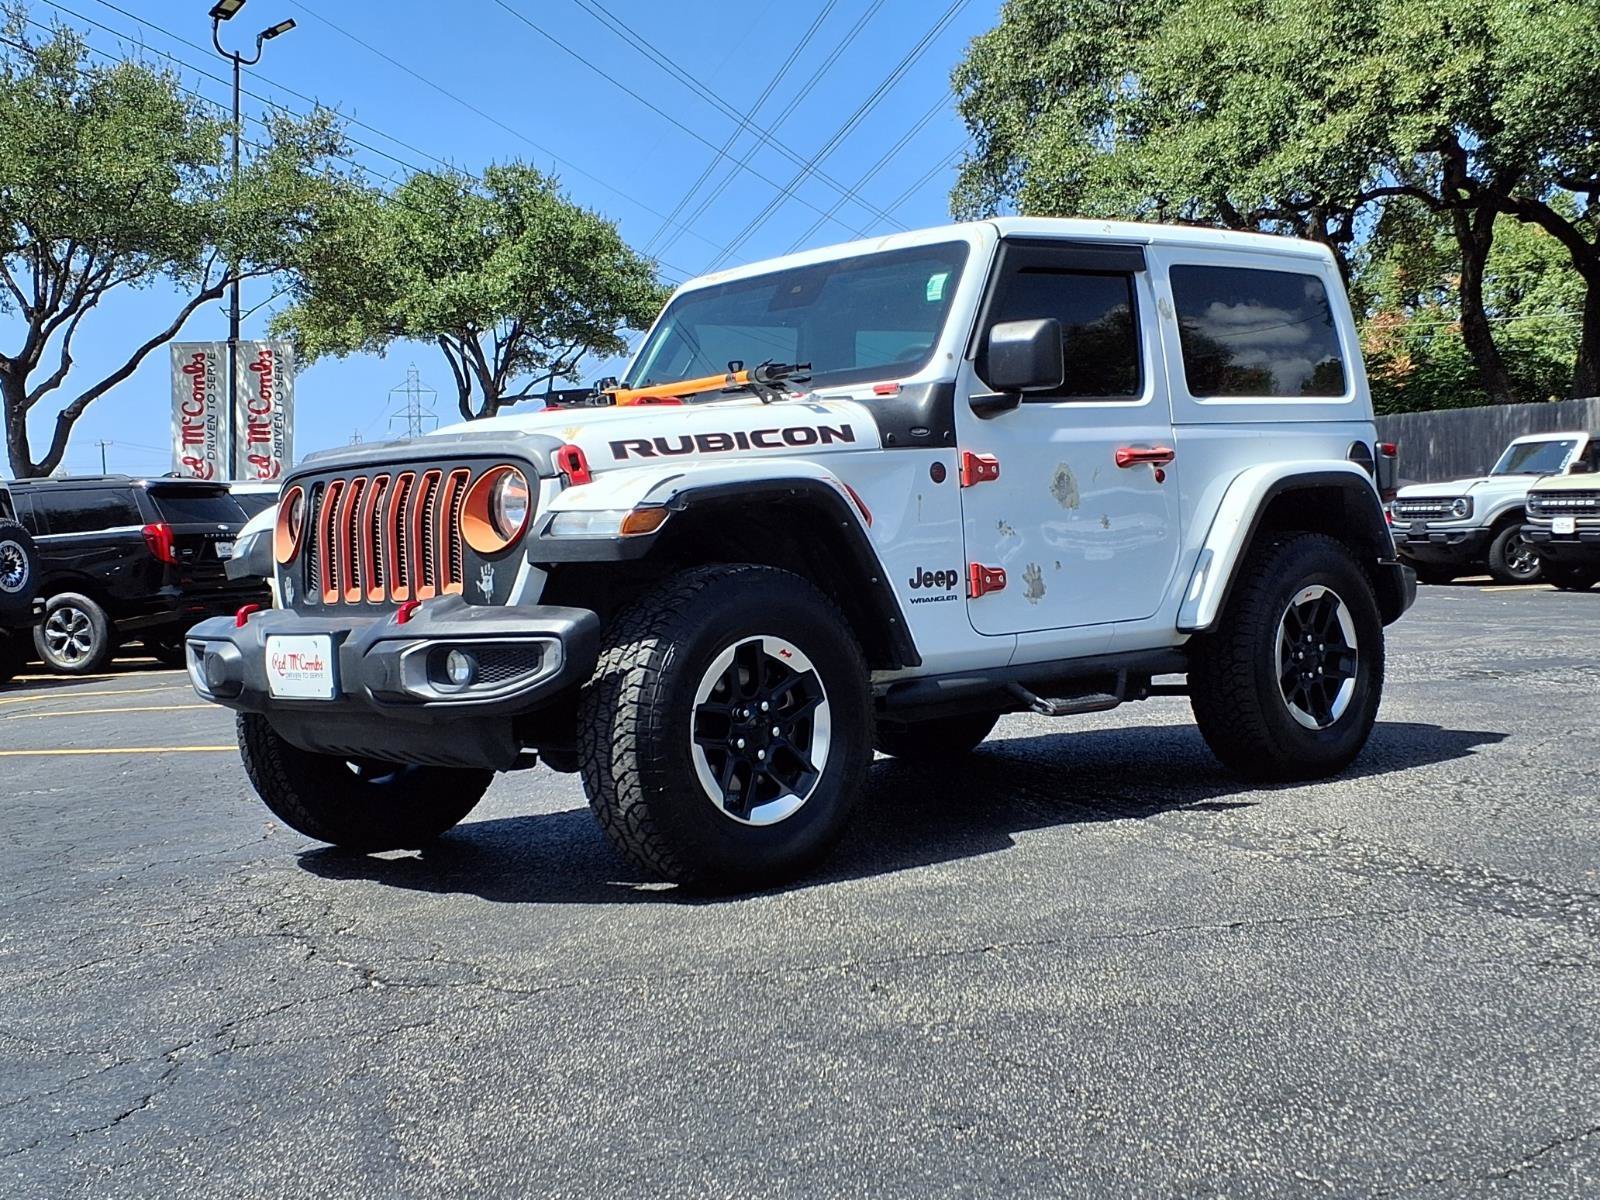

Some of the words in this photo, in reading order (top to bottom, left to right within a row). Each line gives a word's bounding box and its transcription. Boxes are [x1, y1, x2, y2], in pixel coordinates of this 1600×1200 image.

[206, 352, 216, 391] SERVE
[274, 350, 284, 388] SERVE
[181, 352, 206, 450] McCombs
[206, 394, 216, 412] TO
[247, 349, 273, 450] McCombs
[274, 391, 284, 410] TO
[206, 416, 216, 461] DRIVEN
[274, 412, 283, 459] DRIVEN
[608, 424, 855, 460] RUBICON
[182, 456, 205, 480] ed
[247, 454, 272, 480] ed
[908, 566, 958, 591] Jeep
[909, 594, 958, 604] WRANGLER
[272, 652, 286, 677] Red
